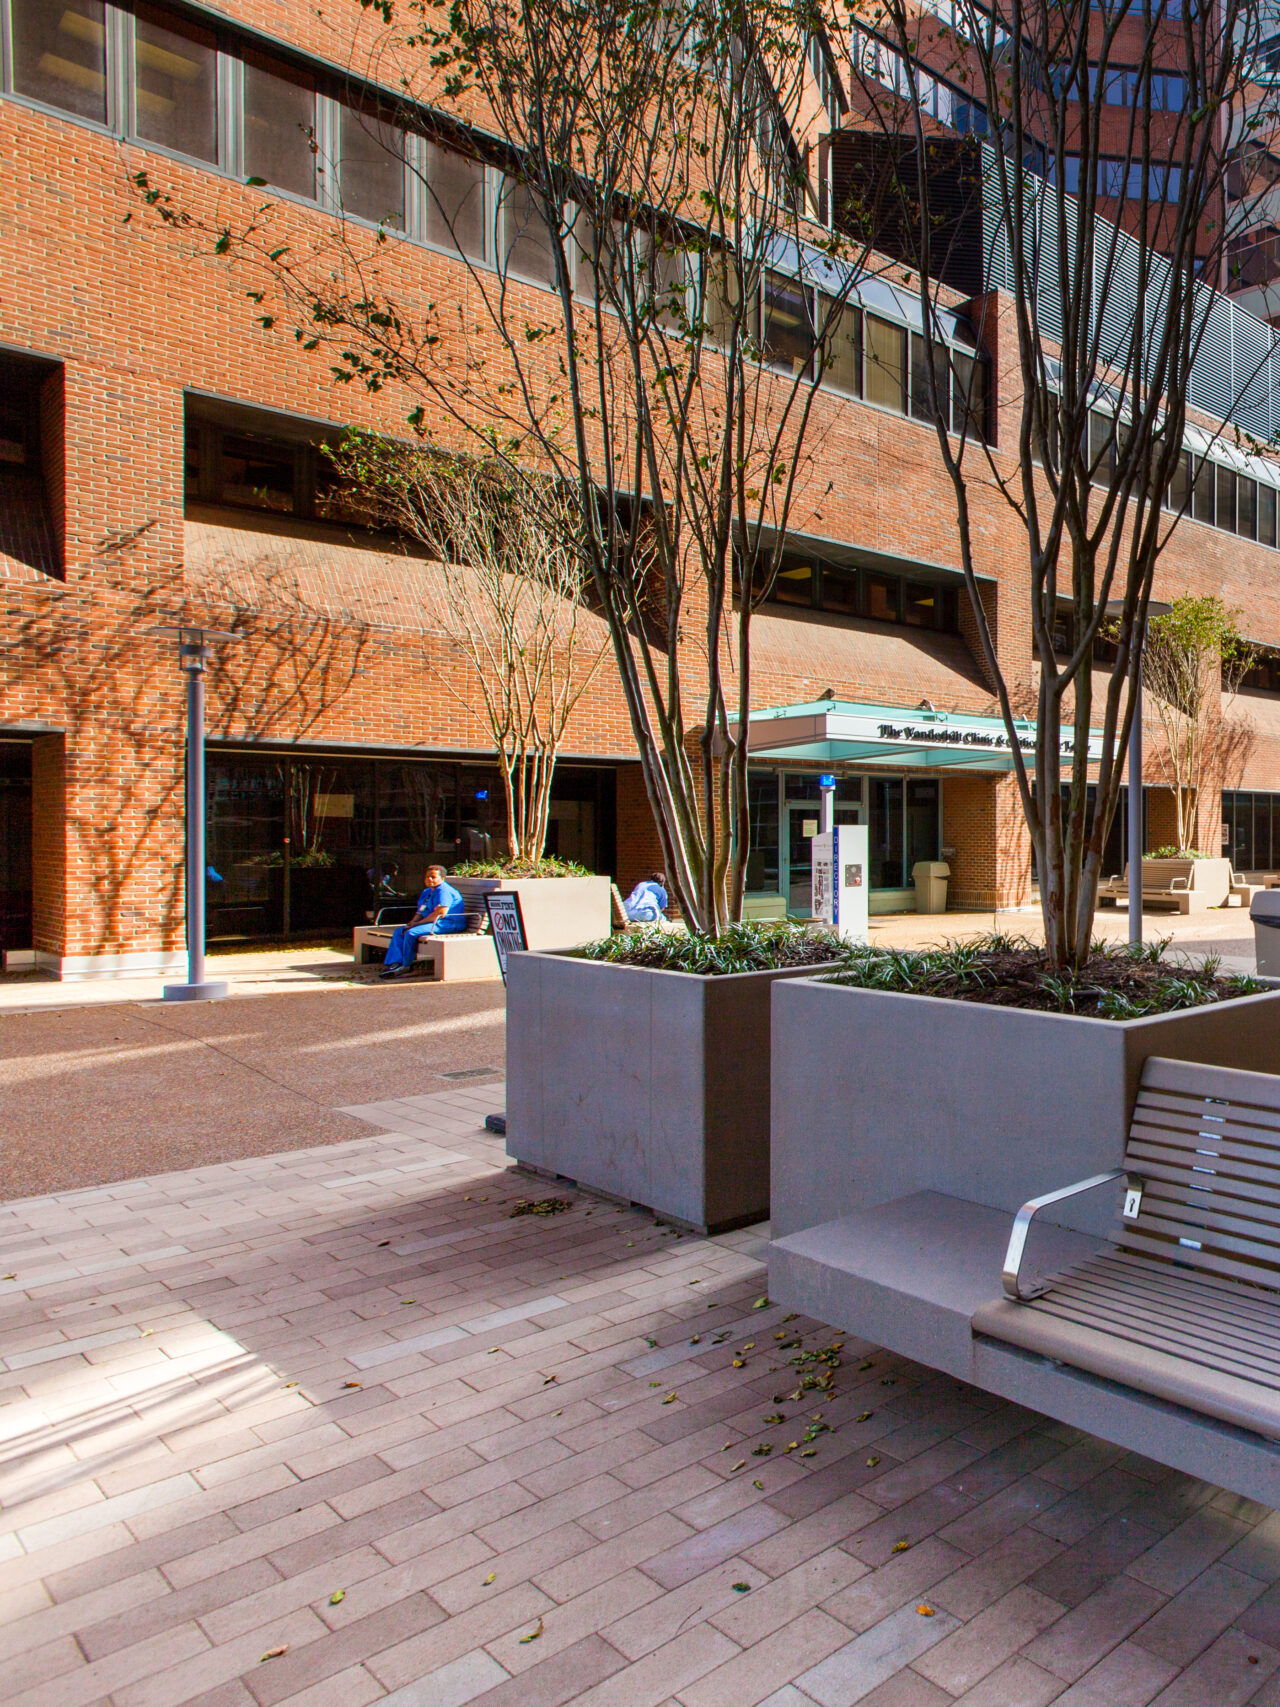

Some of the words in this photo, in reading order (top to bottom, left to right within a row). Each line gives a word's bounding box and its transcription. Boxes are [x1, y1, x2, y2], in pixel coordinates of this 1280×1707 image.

[877, 724, 903, 739] The
[903, 726, 962, 744] Vanderbilt
[963, 732, 994, 746] Clinic
[995, 734, 1005, 748] &
[502, 913, 517, 931] NO
